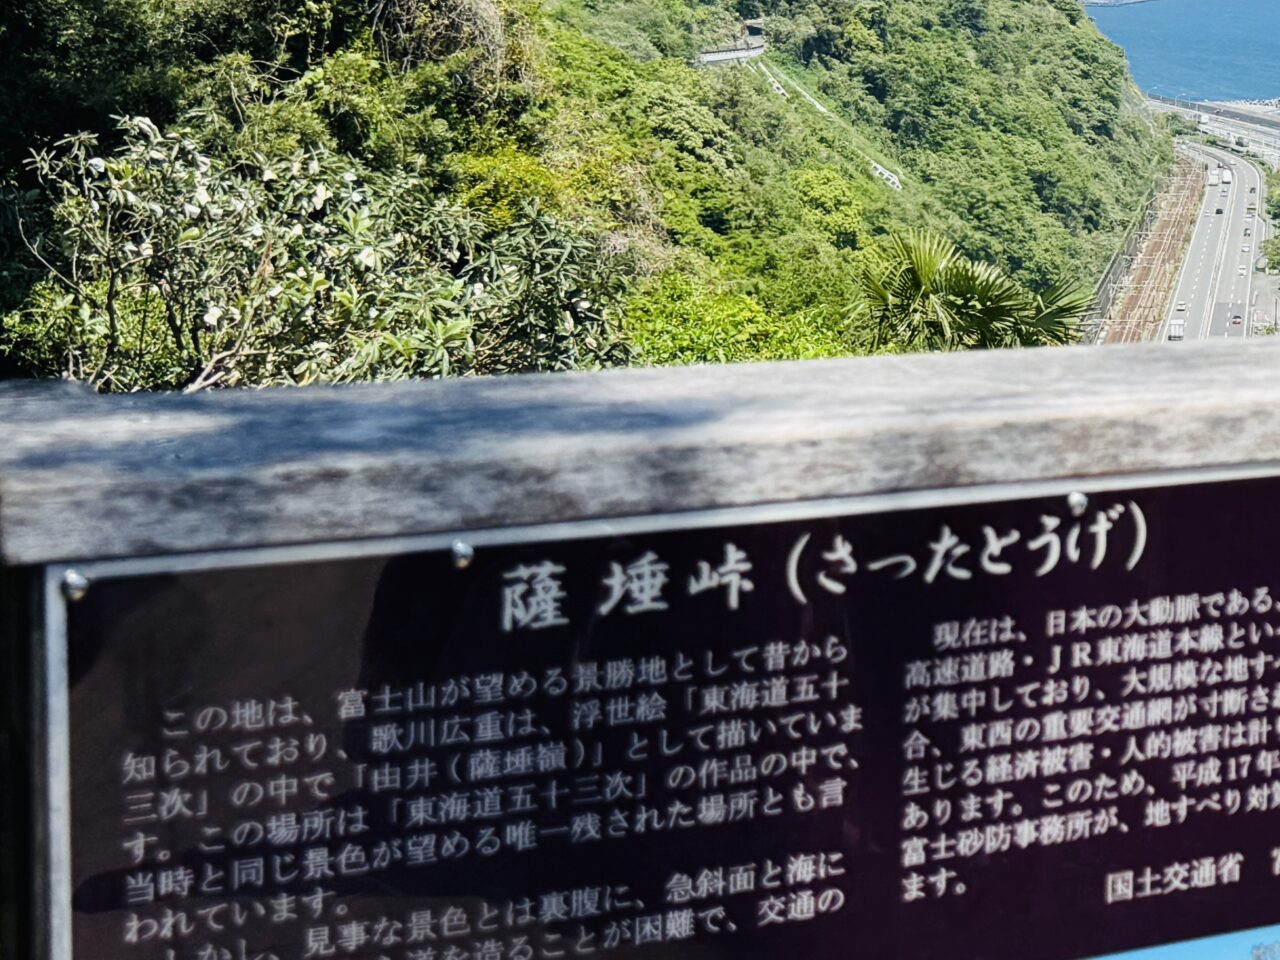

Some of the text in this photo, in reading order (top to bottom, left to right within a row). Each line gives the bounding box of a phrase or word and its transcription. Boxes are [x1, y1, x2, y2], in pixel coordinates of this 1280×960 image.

[902, 867, 966, 902] ます。
[1105, 853, 1244, 904] 国土交通省
[124, 887, 349, 942] われています。
